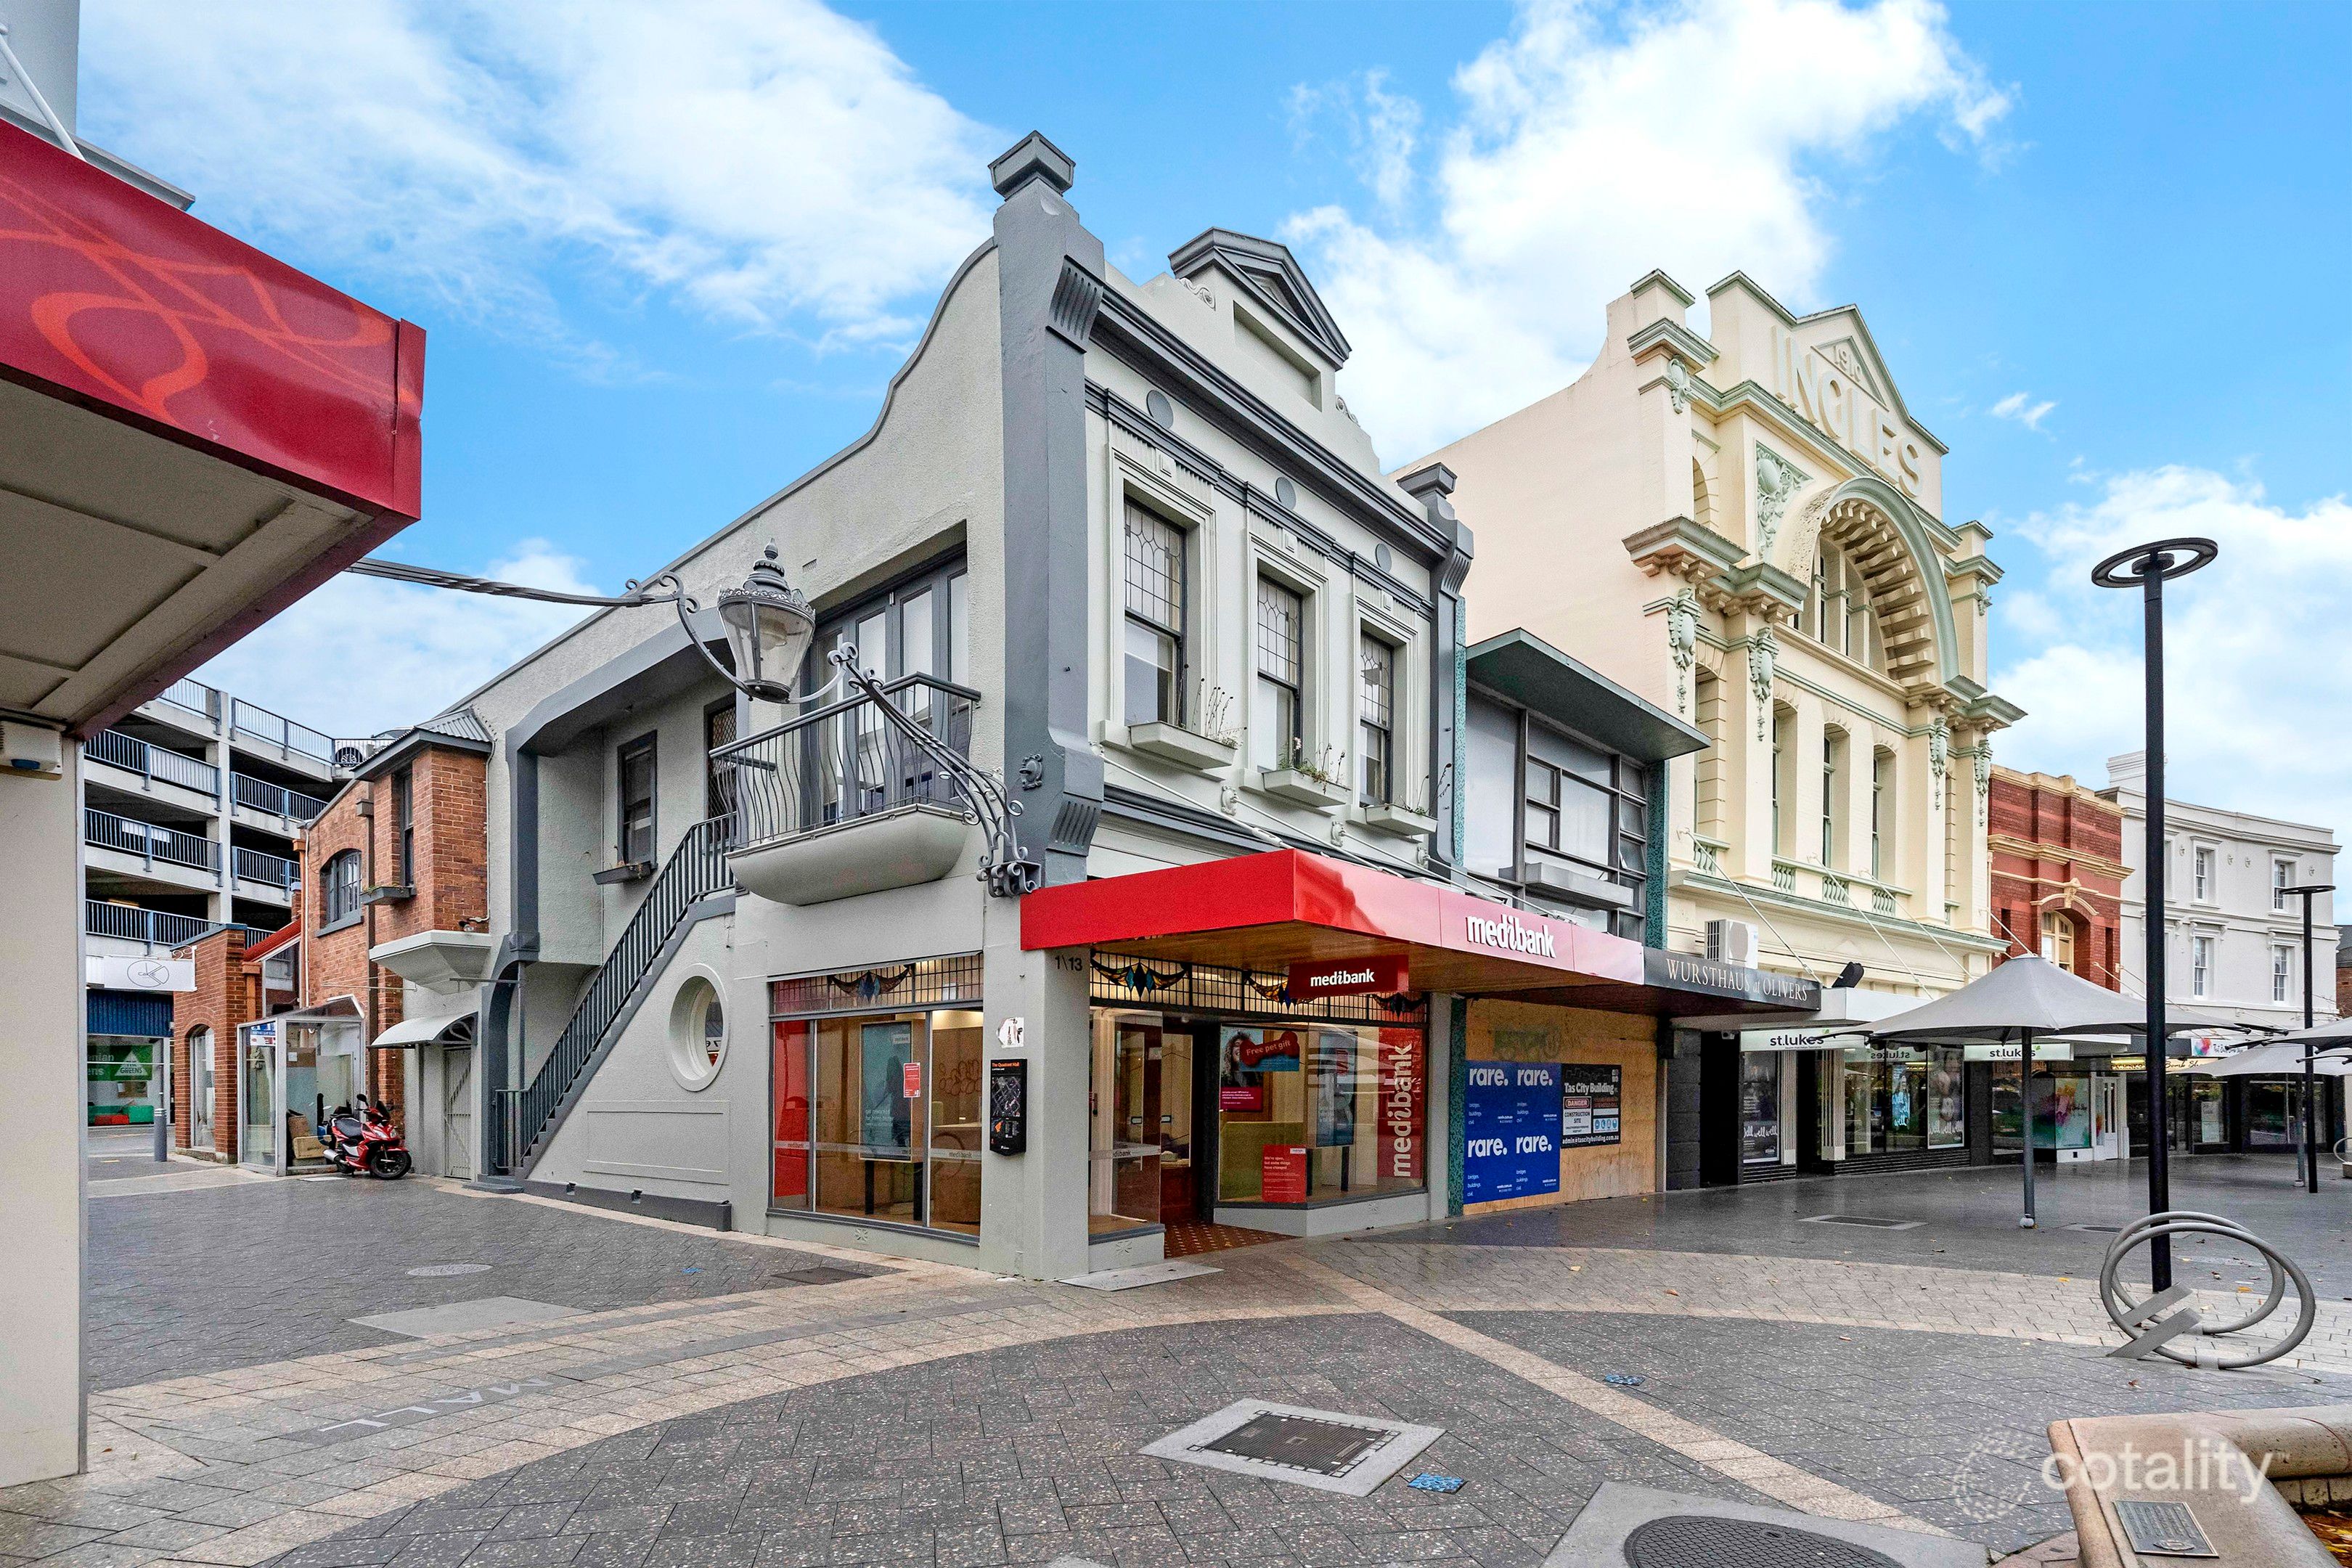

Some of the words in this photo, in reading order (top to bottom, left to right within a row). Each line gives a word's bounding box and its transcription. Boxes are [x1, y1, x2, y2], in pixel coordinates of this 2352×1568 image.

[1465, 914, 1556, 958] medibank
[1310, 968, 1375, 987] medibank
[1666, 958, 1749, 992] WURSTHAUS
[1753, 981, 1760, 995] at
[1763, 979, 1808, 1002] OLIVERS
[1246, 1048, 1264, 1056] Free
[1265, 1044, 1278, 1053] pet
[1278, 1040, 1291, 1050] gift
[1989, 1048, 2035, 1057] st.luks
[1469, 1068, 1509, 1086] rare.
[1517, 1069, 1553, 1086] rare.
[1564, 1082, 1575, 1093] Tas
[1576, 1082, 1589, 1095] City
[1590, 1082, 1614, 1095] Building
[1388, 1043, 1412, 1177] medibank
[1468, 1138, 1508, 1158] rare.
[1516, 1135, 1552, 1153] rare.
